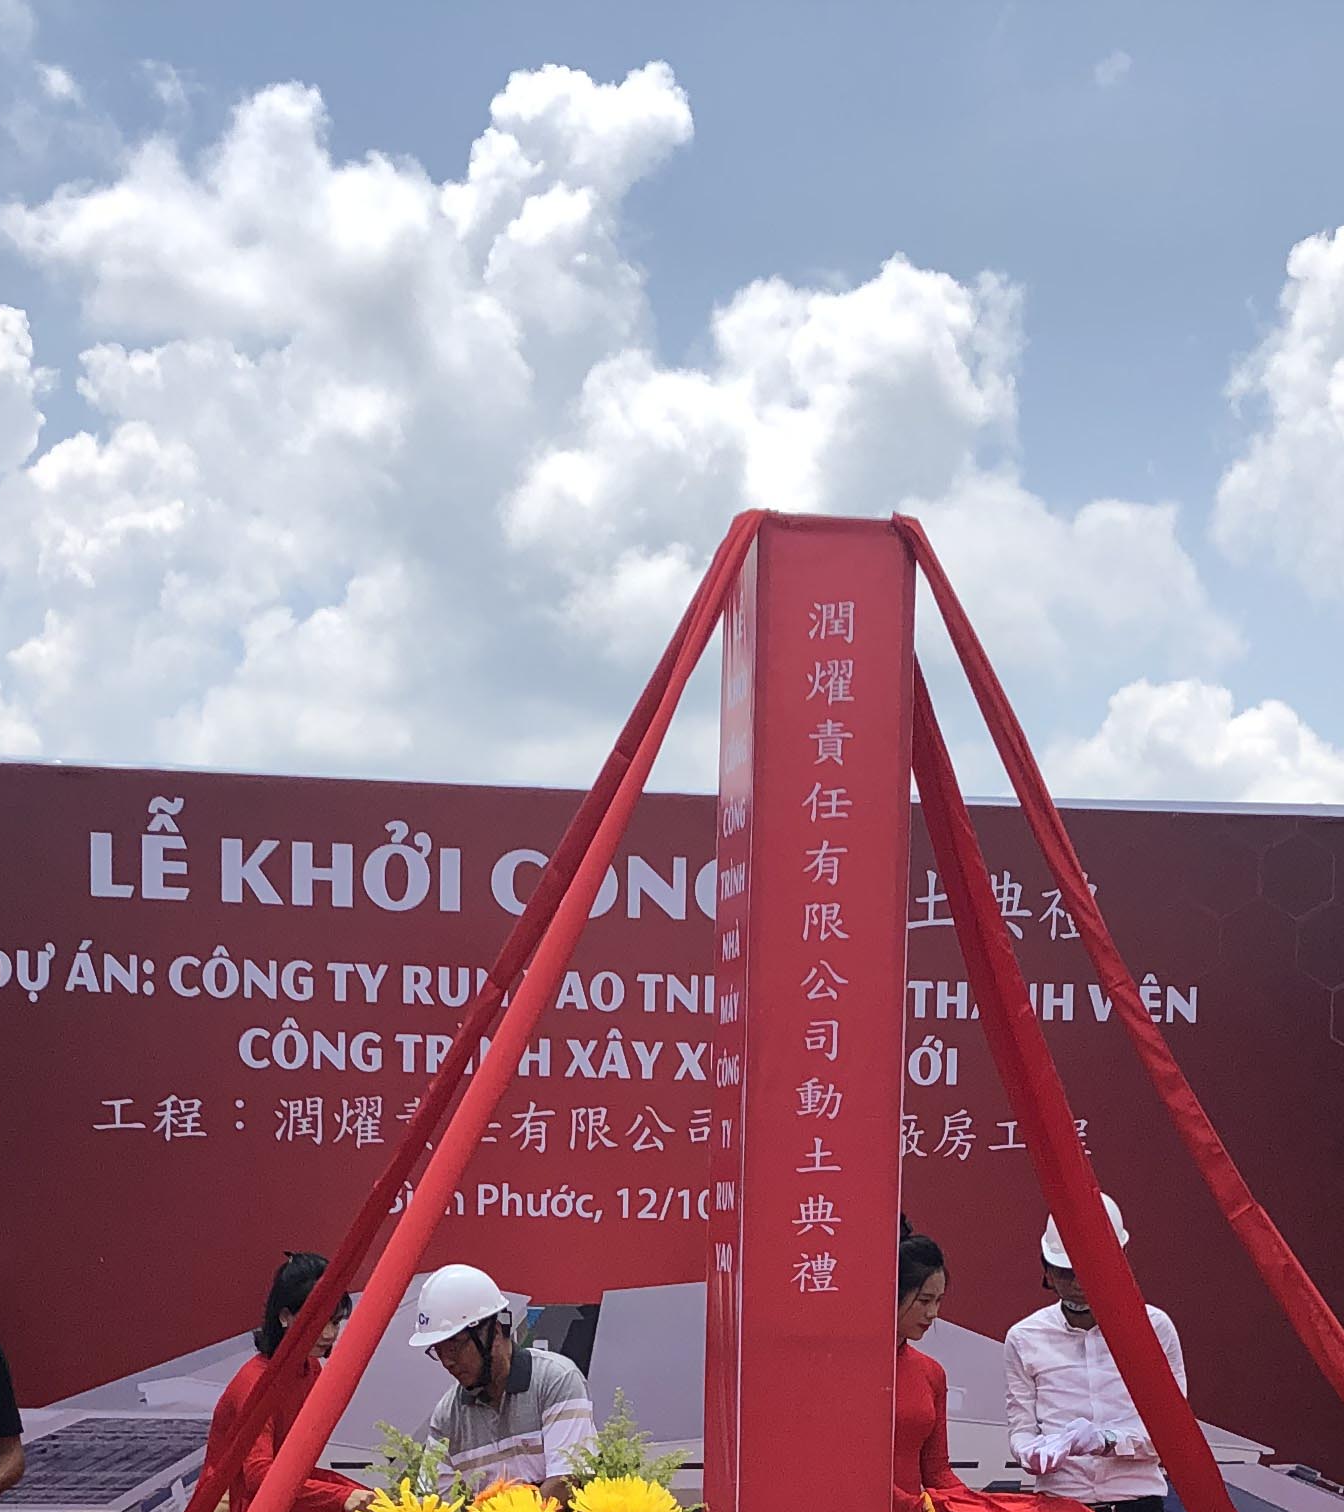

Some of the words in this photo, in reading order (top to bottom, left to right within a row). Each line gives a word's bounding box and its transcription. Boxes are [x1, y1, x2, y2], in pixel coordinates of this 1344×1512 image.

[90, 796, 191, 901] LỄ
[221, 820, 462, 912] KHỞI
[721, 858, 746, 901] TRÌNH
[722, 918, 740, 962] NHÀ
[64, 939, 155, 996] ÁN:
[168, 945, 315, 1000] CÔNG
[327, 963, 388, 1003] TY
[1087, 973, 1198, 1023] VÊN
[720, 984, 740, 1024] MÁY
[239, 1017, 383, 1072] CÔNG
[565, 1028, 664, 1081] XÂY
[716, 1048, 740, 1088] CÔNG
[721, 1119, 733, 1149] TY
[477, 1182, 602, 1223] Phước,
[716, 1181, 735, 1211] RUN
[715, 1243, 733, 1273] YAO
